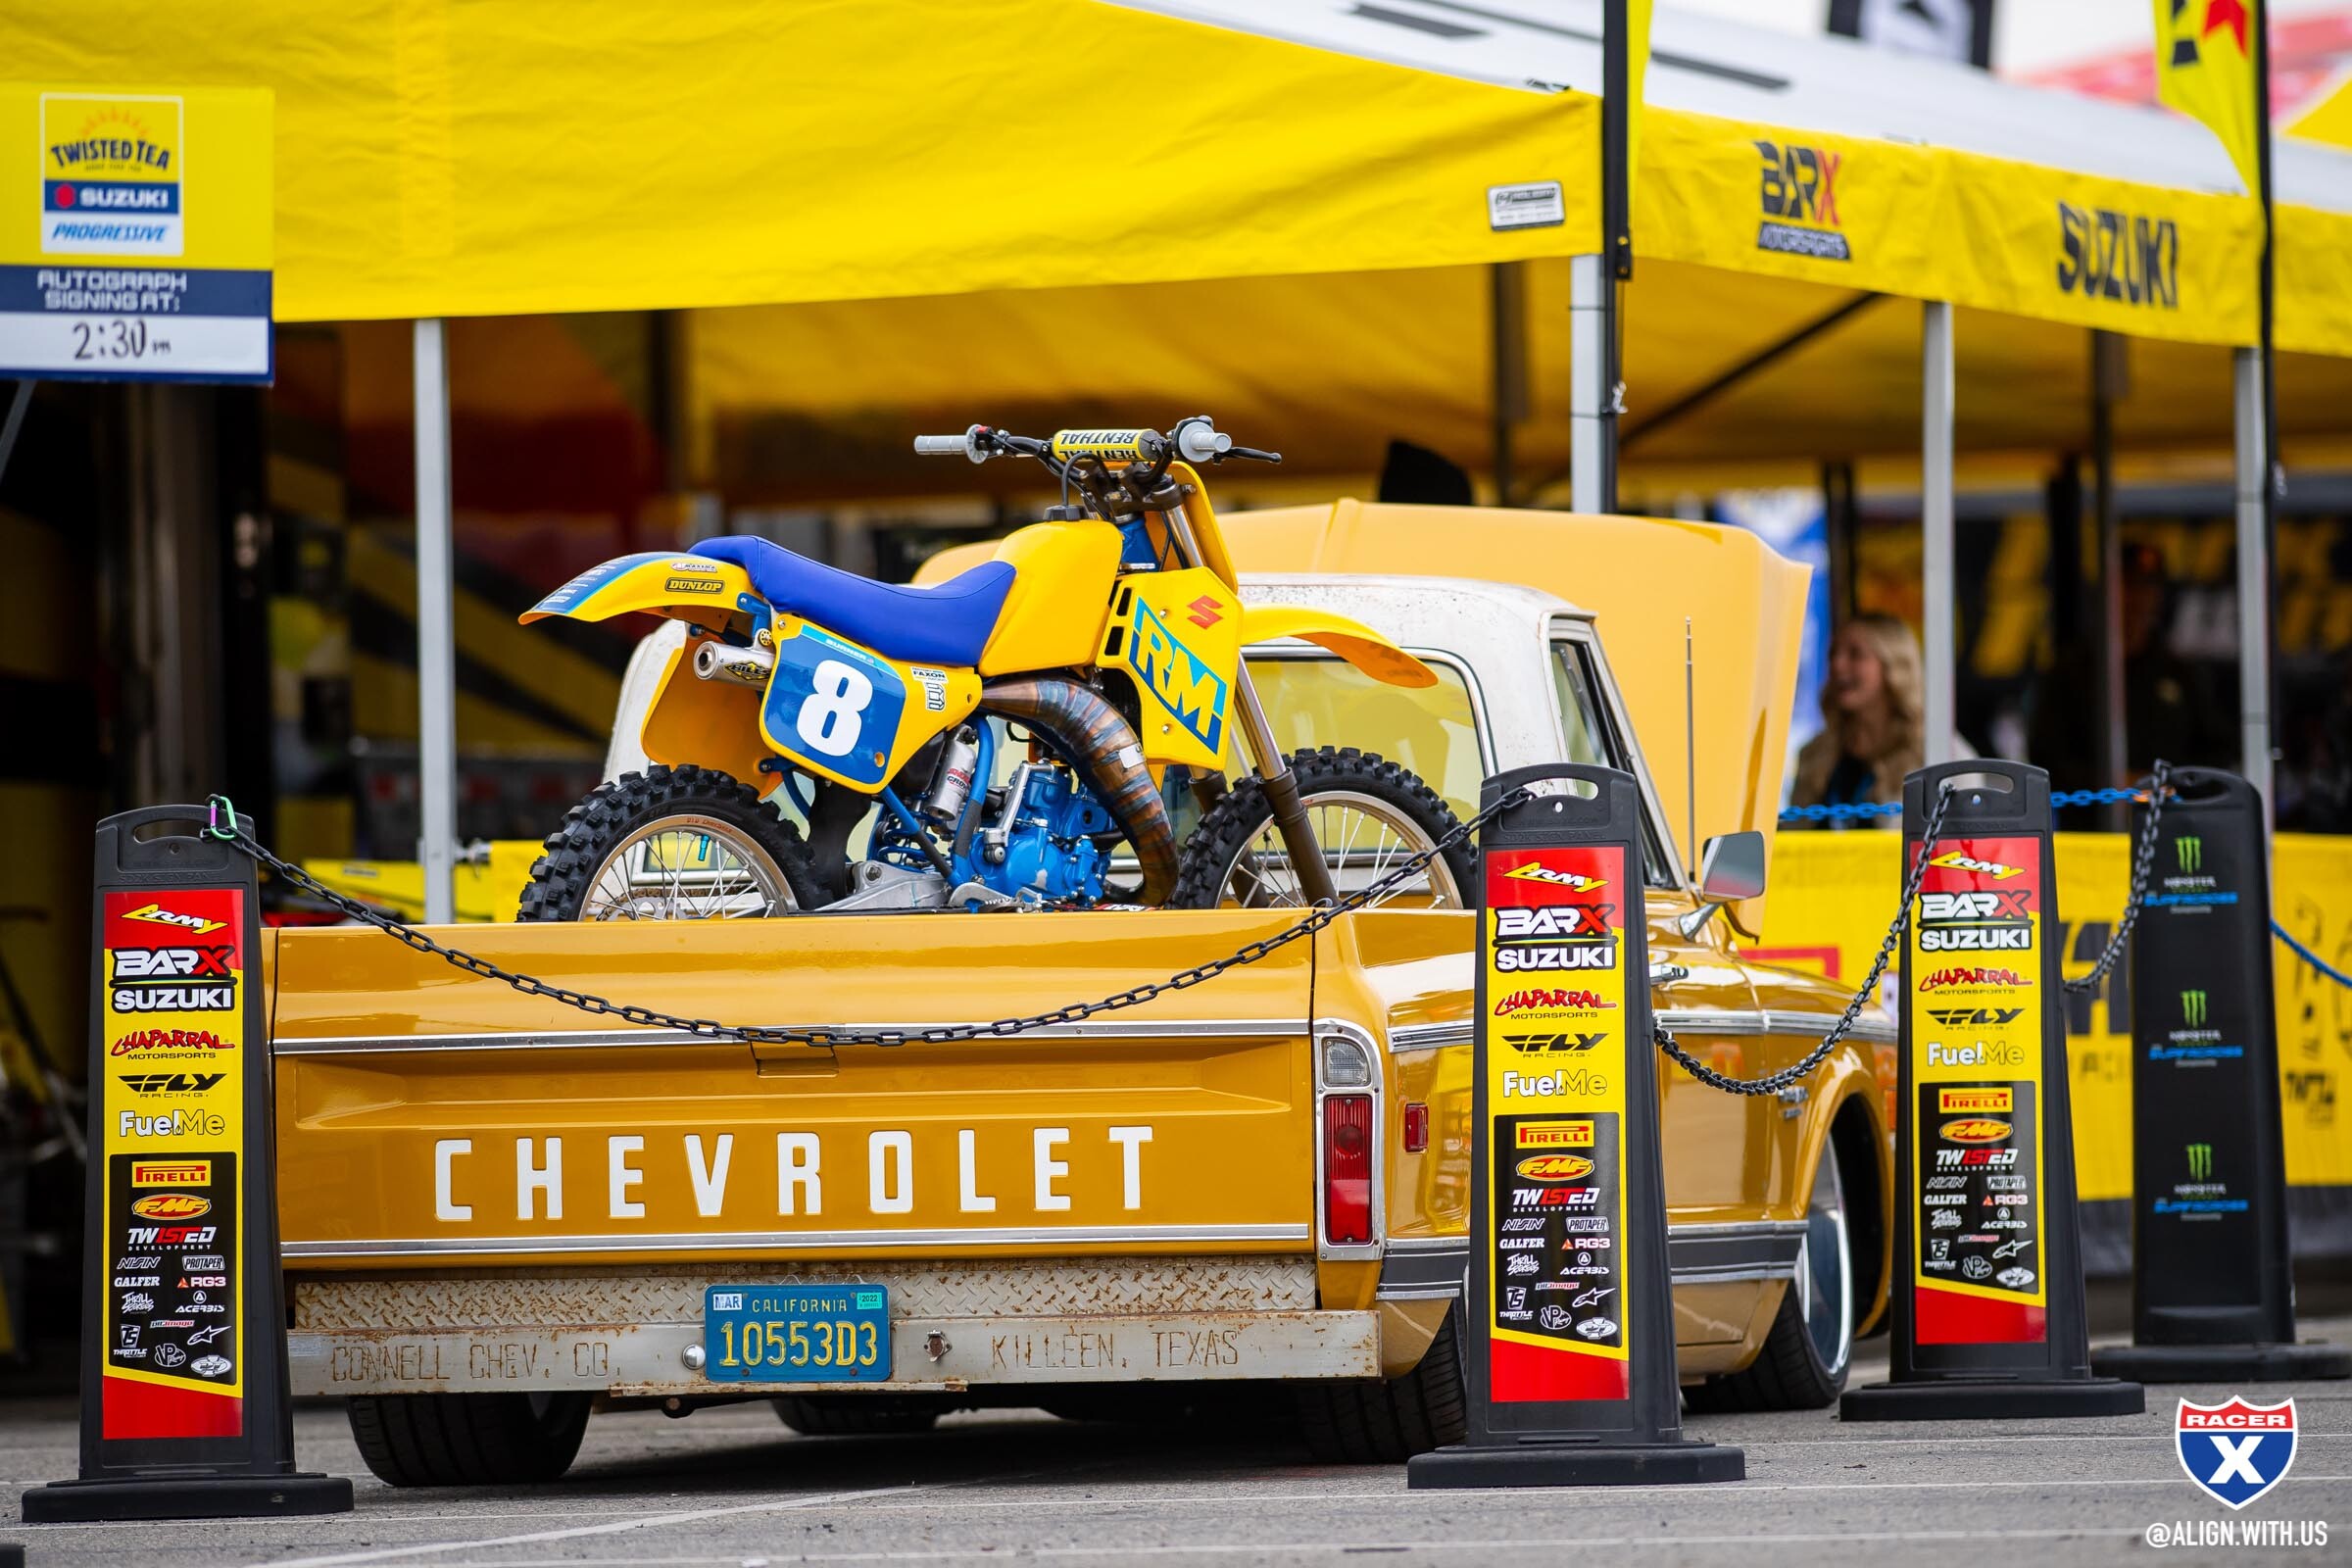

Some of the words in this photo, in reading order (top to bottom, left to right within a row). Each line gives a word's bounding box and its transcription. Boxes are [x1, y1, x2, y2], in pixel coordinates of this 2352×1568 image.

[51, 138, 132, 170] TWISTED
[136, 139, 171, 171] TEA
[79, 187, 169, 208] SUZUKI
[51, 222, 169, 242] PROGRESSIVE
[2058, 200, 2180, 310] SUZUKI
[37, 270, 187, 292] AUTOGRAPH
[44, 290, 138, 311] SIGNING
[141, 292, 180, 312] AT:
[73, 318, 147, 360] 2:30
[1060, 432, 1138, 445] RENTHAL
[668, 580, 722, 592] DUNLOP
[912, 669, 946, 679] FAXON
[1136, 610, 1219, 739] RM
[797, 660, 873, 757] 8
[1929, 851, 2026, 880] ARMY
[1503, 861, 1609, 893] ARMY
[1921, 893, 2029, 918] BARX
[122, 904, 228, 934] ARMY
[1496, 906, 1612, 935] BARX
[1921, 929, 2030, 951] SUZUKI
[115, 948, 233, 976] BARX
[1497, 947, 1613, 969] SUZUKI
[1919, 967, 2033, 992] CHAPARRAL
[115, 988, 231, 1009] SUZUKI
[1494, 989, 1616, 1016] CHAPARRAL
[1926, 1008, 2026, 1025] FLY
[111, 1029, 235, 1056] CHAPARRAL
[1501, 1033, 1609, 1052] FLY
[1928, 1042, 2024, 1066] FuelMe
[118, 1073, 227, 1092] FLY
[1503, 1069, 1607, 1098] FuelMe
[1943, 1094, 2008, 1107] PIRELLI
[120, 1109, 224, 1137] FuelMe
[1941, 1124, 2012, 1137] FMF
[1520, 1126, 1589, 1143] PIRELLI
[1518, 1159, 1593, 1175] FMF
[1936, 1149, 2019, 1165] TWISTED
[135, 1165, 207, 1182] PIRELLI
[434, 1126, 1153, 1221] CHEVROLET
[134, 1199, 210, 1214] FMF
[1512, 1188, 1600, 1205] TWISTED
[1924, 1195, 1968, 1205] GALFER
[1994, 1195, 2029, 1205] RG3
[128, 1226, 217, 1244] TWISTED
[1499, 1238, 1544, 1249] GALFER
[1575, 1238, 1611, 1249] RG3
[1560, 1266, 1610, 1275] ACERBIS
[114, 1276, 160, 1287] GALFER
[190, 1276, 226, 1287] RG3
[175, 1304, 225, 1313] ACERBIS
[752, 1298, 848, 1313] CALIFORNIA
[1499, 1310, 1534, 1319] THROTTLE
[113, 1348, 148, 1357] THROTTLE
[719, 1321, 878, 1367] 10553D3
[1151, 1329, 1240, 1367] TEXAS
[332, 1345, 451, 1382] CONNELL
[469, 1343, 551, 1380] CHEV.
